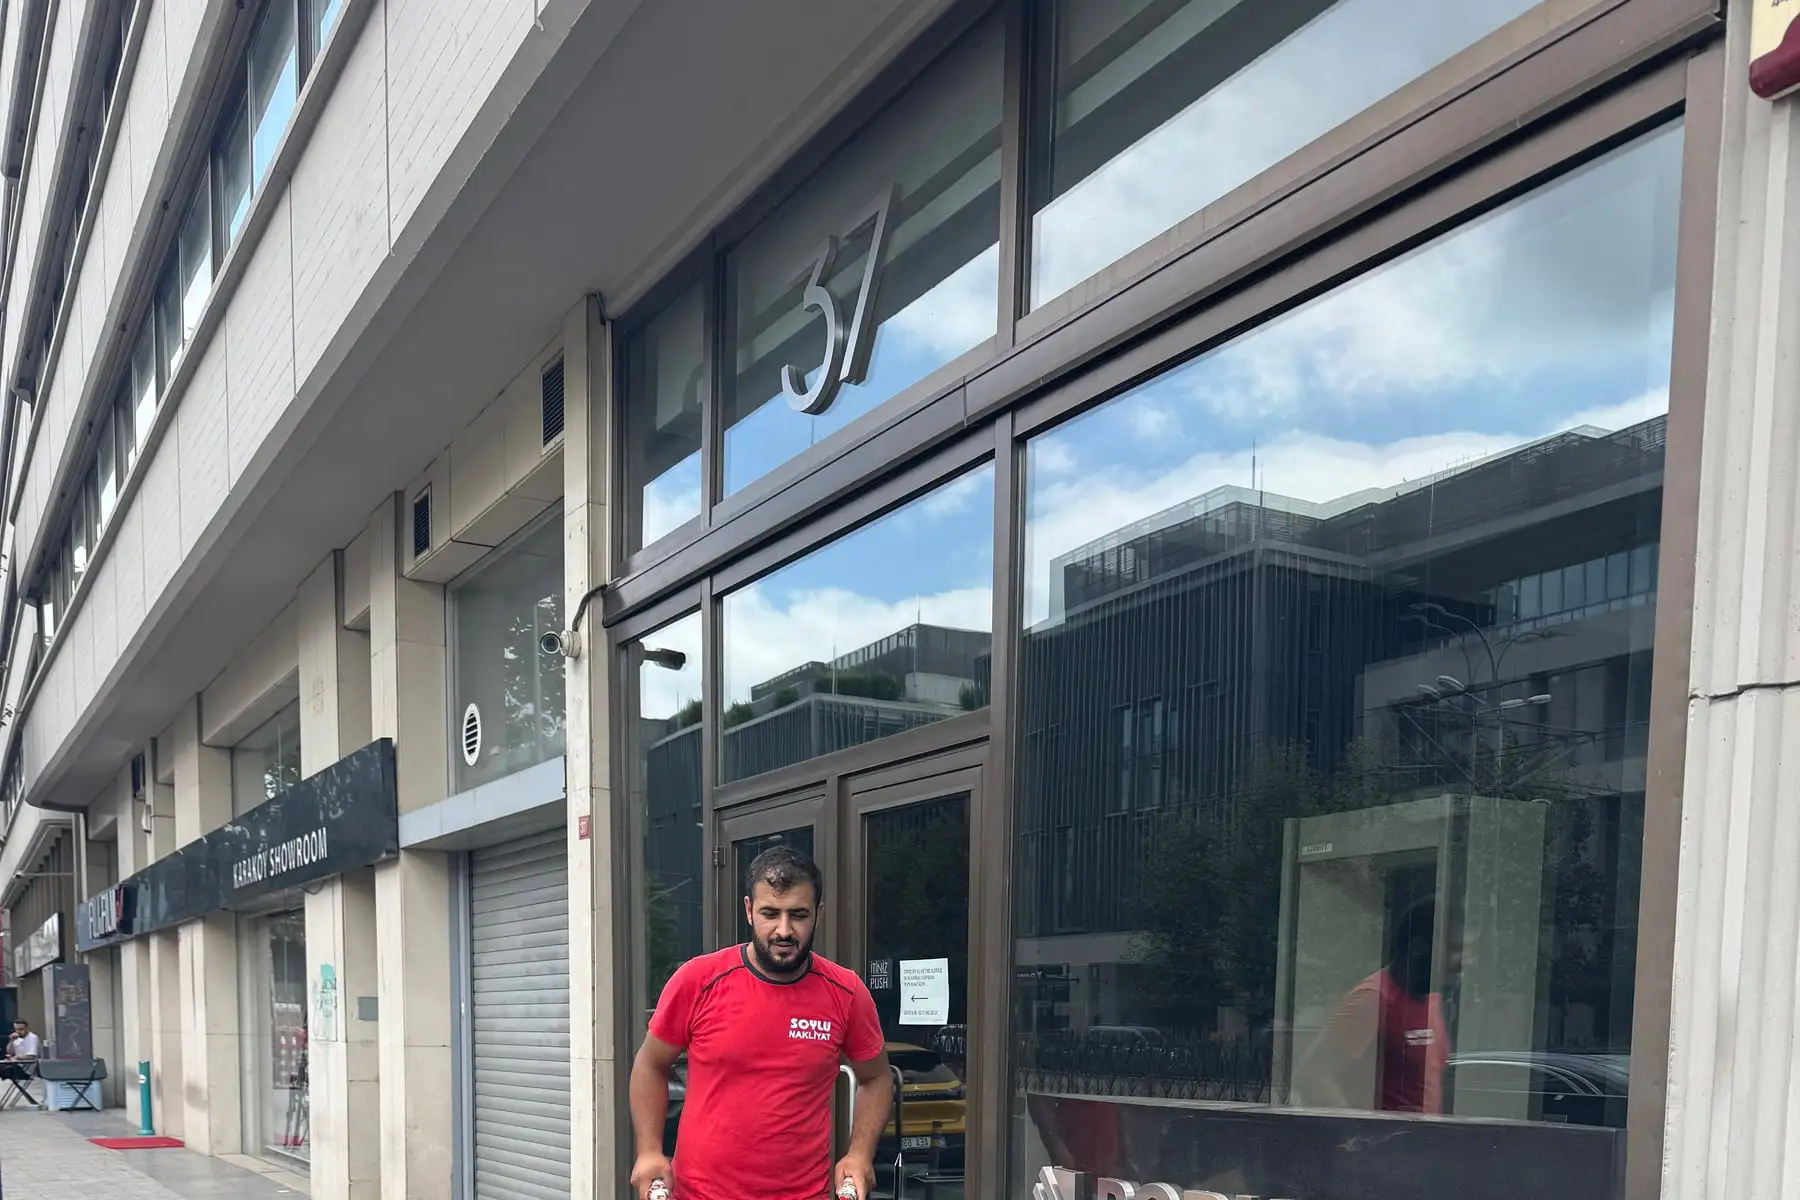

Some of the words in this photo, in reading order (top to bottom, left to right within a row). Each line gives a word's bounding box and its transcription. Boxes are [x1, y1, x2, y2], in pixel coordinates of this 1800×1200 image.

[269, 827, 328, 877] SHOWROOM
[870, 977, 888, 989] PUSH
[790, 1018, 831, 1032] SOYLU
[788, 1030, 831, 1041] NAKLİYAT
